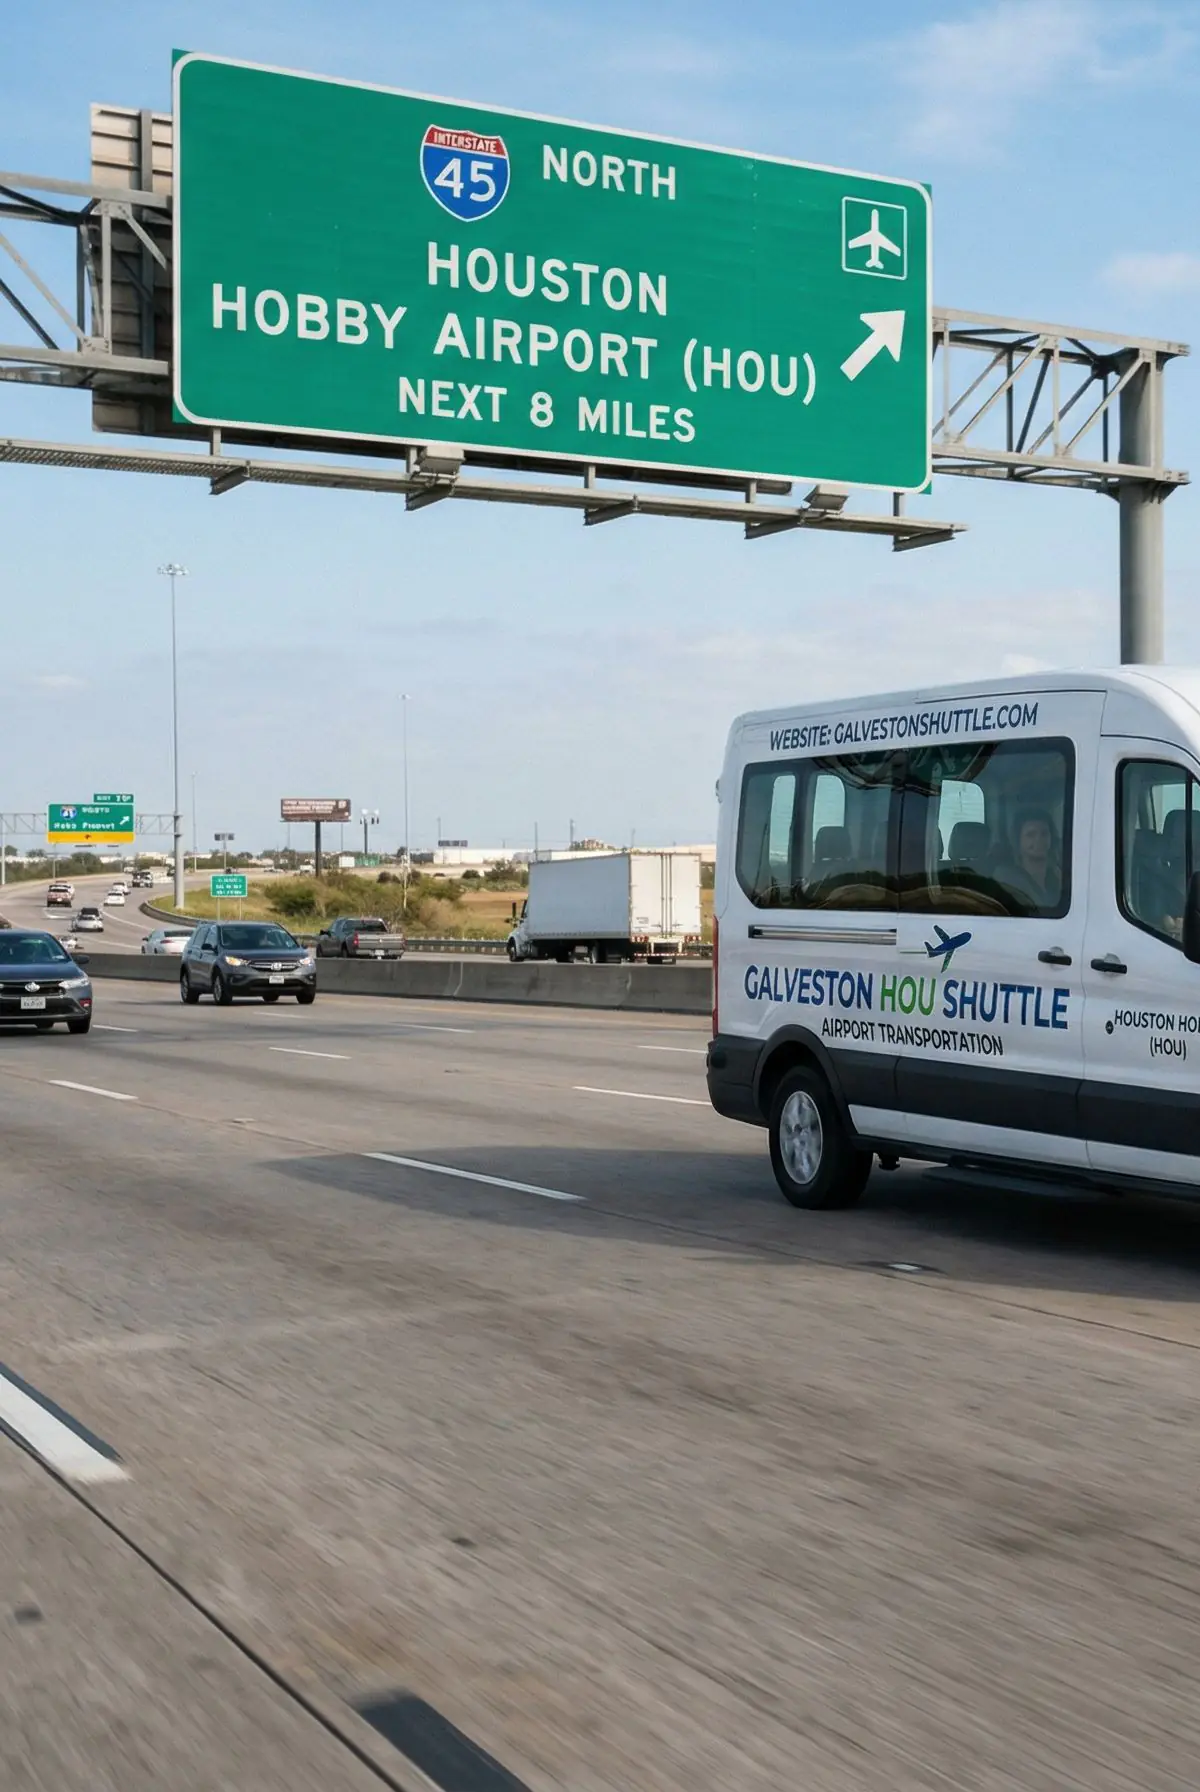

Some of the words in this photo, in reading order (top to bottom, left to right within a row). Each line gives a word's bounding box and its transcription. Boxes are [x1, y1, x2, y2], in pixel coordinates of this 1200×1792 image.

[433, 131, 497, 153] INTERSTATE
[434, 158, 496, 202] 45
[543, 144, 676, 200] NORTH
[427, 241, 668, 316] HOUSTON
[212, 284, 407, 350] HOBBY
[433, 312, 658, 380] AIRPORT
[684, 338, 817, 405] (HOU)
[399, 377, 507, 422] NEXT
[530, 391, 554, 427] 8
[579, 396, 696, 442] MILES
[769, 726, 831, 751] WEBSITE:
[834, 702, 1038, 743] GALVESTONSHUTTLE.COM
[744, 965, 873, 1011] GALVESTON
[880, 975, 936, 1015] HOU
[942, 979, 1070, 1030] SHUTTLE
[1114, 1009, 1175, 1031] HOUSTON
[821, 1016, 876, 1043] AIRPORT
[880, 1023, 1004, 1056] TRANSPORTATION
[1150, 1036, 1187, 1061] (HOU)
